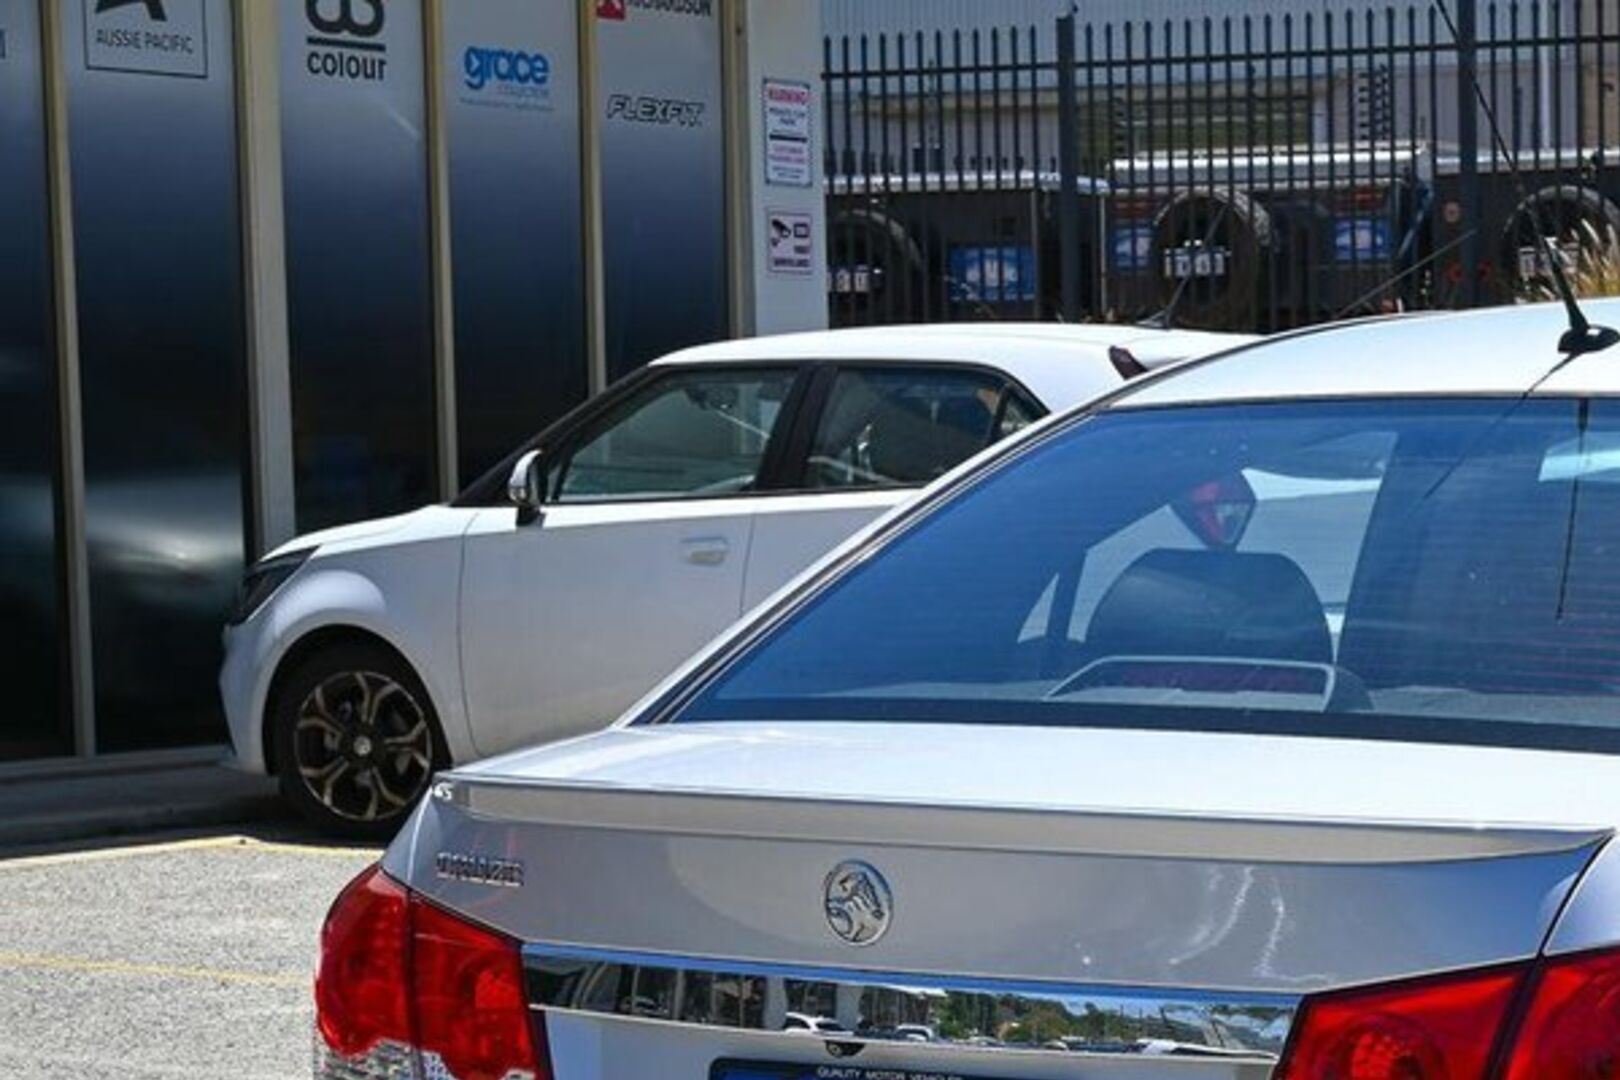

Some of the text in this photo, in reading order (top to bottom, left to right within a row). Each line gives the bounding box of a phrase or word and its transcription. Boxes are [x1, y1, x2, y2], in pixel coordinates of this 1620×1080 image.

[96, 29, 193, 54] AUSSIE PACIFIC
[308, 52, 386, 80] colour
[464, 46, 549, 90] grace
[606, 94, 705, 127] FLEXFIT
[816, 1066, 861, 1079] QUALITY
